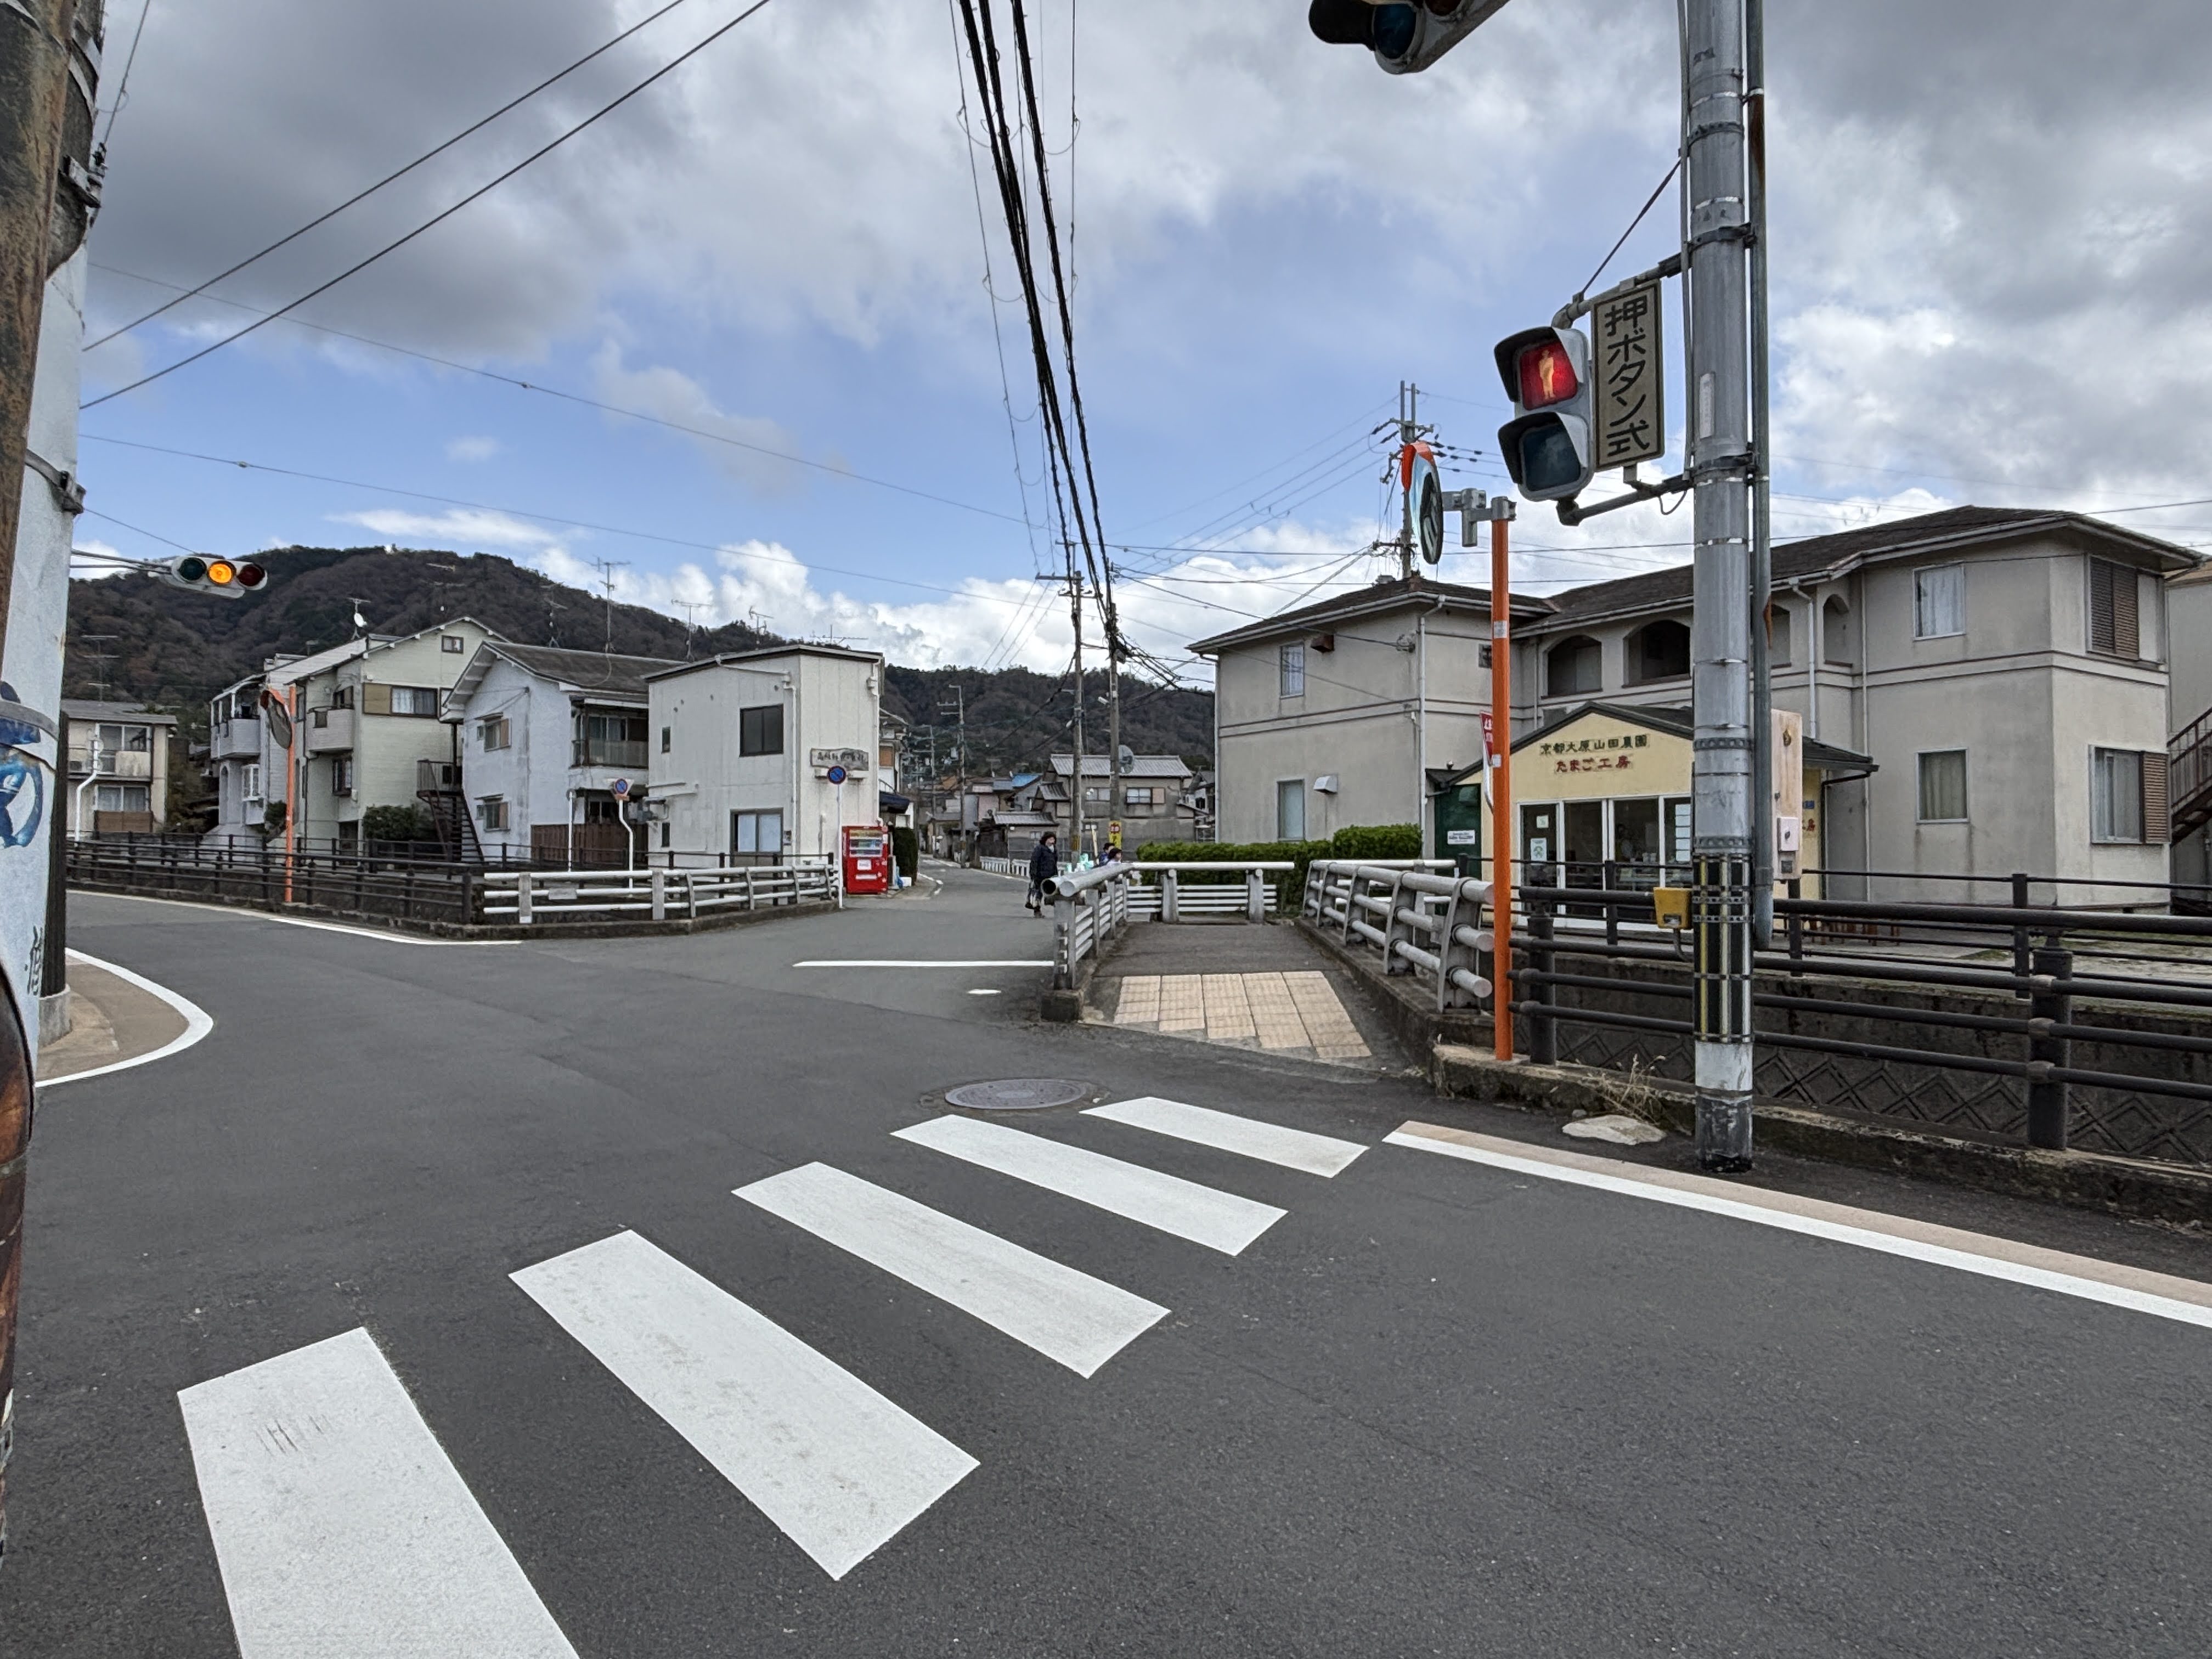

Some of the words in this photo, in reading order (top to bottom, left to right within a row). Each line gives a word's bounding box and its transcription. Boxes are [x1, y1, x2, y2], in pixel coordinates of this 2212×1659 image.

[1604, 294, 1650, 457] 押ボタン式
[1541, 734, 1647, 755] 京都大原山田農園
[1556, 755, 1631, 772] たまご工房
